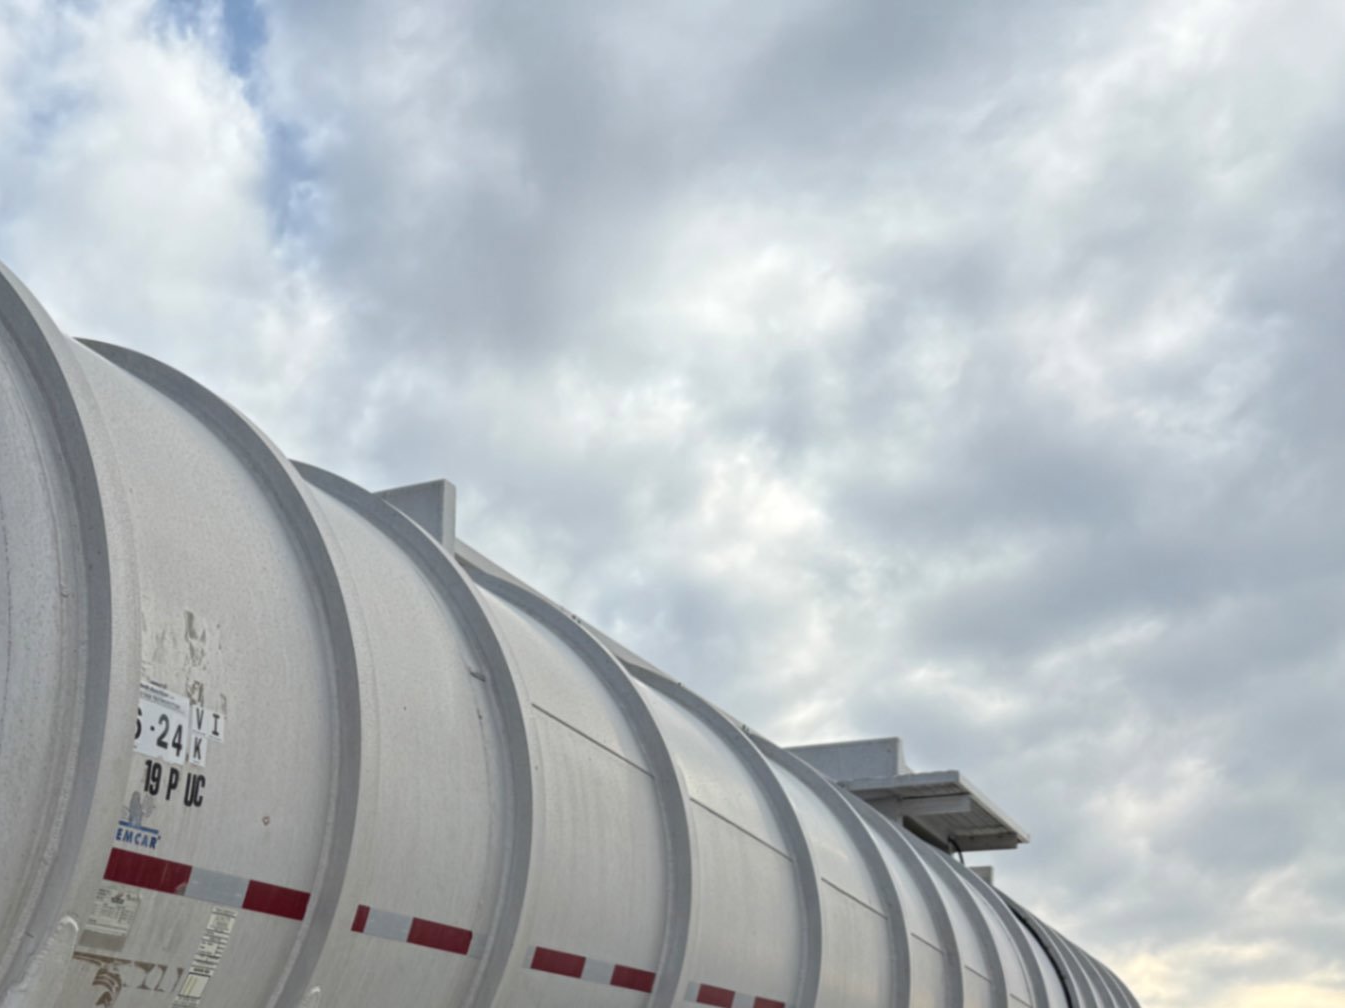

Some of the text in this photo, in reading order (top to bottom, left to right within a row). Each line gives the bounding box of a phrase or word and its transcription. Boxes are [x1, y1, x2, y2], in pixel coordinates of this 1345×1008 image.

[144, 759, 206, 807] 19 P UC
[115, 827, 158, 850] EMCAR
